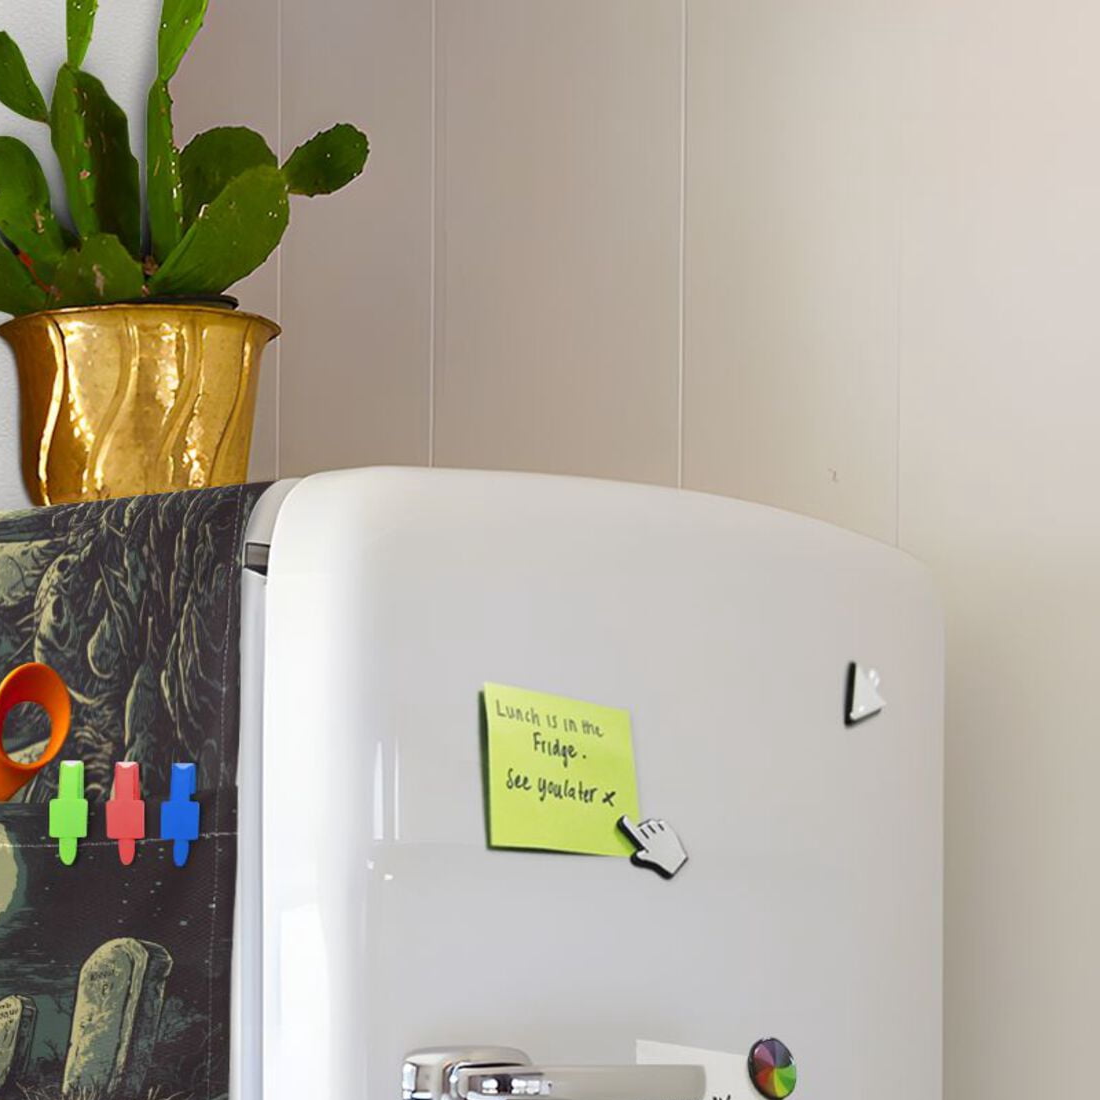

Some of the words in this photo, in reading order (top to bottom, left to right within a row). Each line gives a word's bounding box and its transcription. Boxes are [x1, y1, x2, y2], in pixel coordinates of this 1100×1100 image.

[496, 699, 540, 727] Lunch
[546, 714, 558, 729] is
[564, 718, 578, 733] in
[582, 720, 604, 738] the
[506, 768, 532, 790] See
